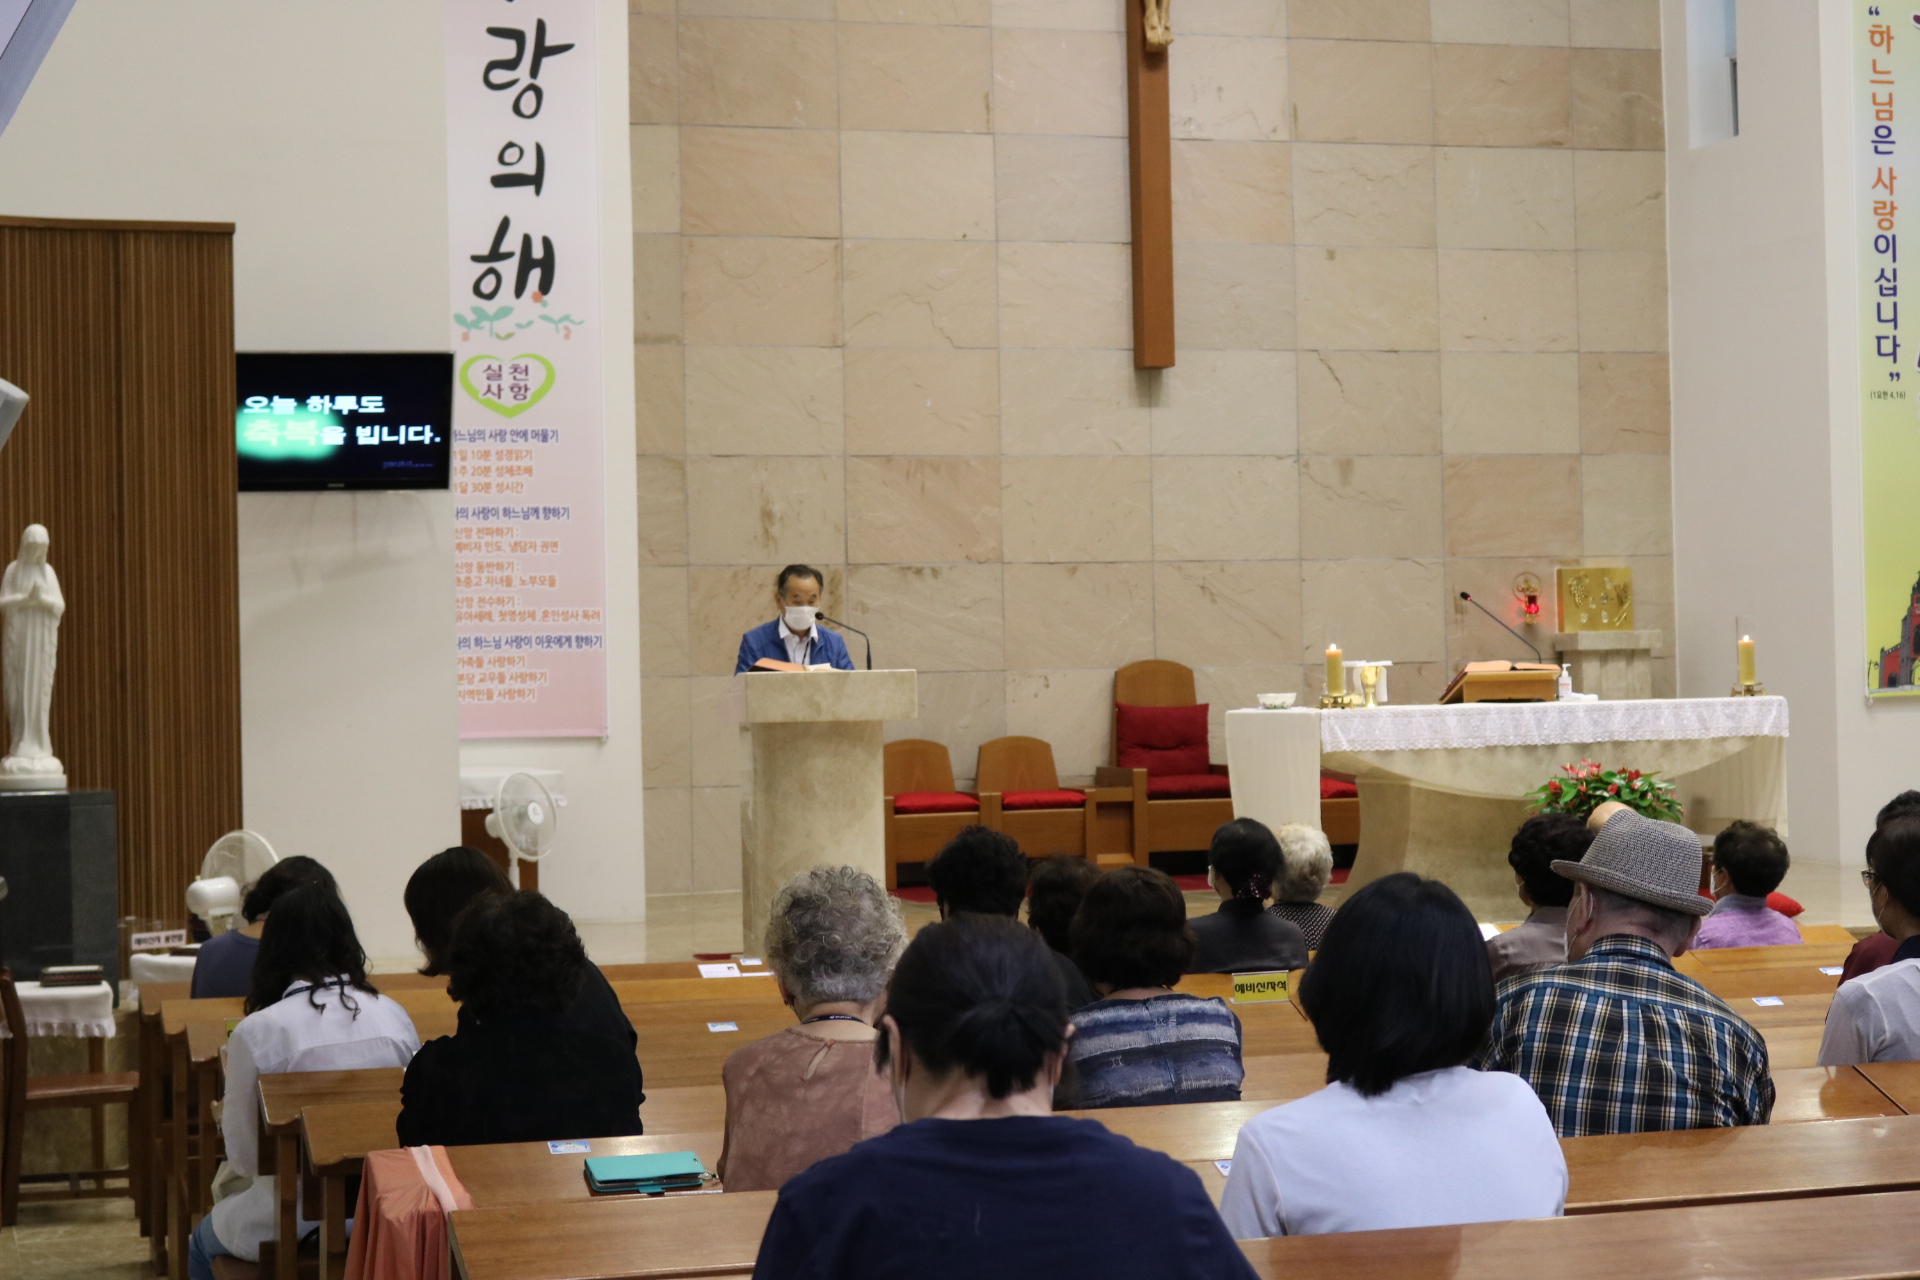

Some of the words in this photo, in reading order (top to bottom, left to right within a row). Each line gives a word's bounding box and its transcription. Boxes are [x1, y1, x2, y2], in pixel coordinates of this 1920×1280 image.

[1868, 6, 1896, 155] “하느님은
[483, 0, 575, 197] 랑의
[470, 215, 556, 301] 해
[1871, 167, 1901, 382] 사랑이십니다”
[482, 364, 530, 381] 실천
[481, 383, 531, 401] 사항
[243, 394, 298, 415] 오늘
[306, 394, 386, 415] 하루도
[243, 419, 347, 447] 축복을
[355, 424, 441, 446] 빕니다.
[488, 429, 507, 443] 사랑
[509, 429, 528, 443] 안에
[531, 429, 559, 443] 머물기
[471, 449, 492, 461] 10분
[495, 449, 533, 461] 성경읽기
[470, 465, 492, 478] 20분
[470, 482, 492, 494] 30분
[495, 482, 524, 494] 성시간
[471, 506, 500, 520] 사랑이
[502, 506, 540, 520] 하느님께
[543, 506, 570, 520] 향하기
[474, 635, 501, 650] 하느님
[504, 635, 532, 650] 사랑이
[535, 635, 572, 650] 이웃에게
[575, 635, 602, 650] 향하기
[487, 656, 525, 668] 사랑하기
[509, 672, 547, 685] 사랑하기
[497, 688, 535, 701] 사랑하기
